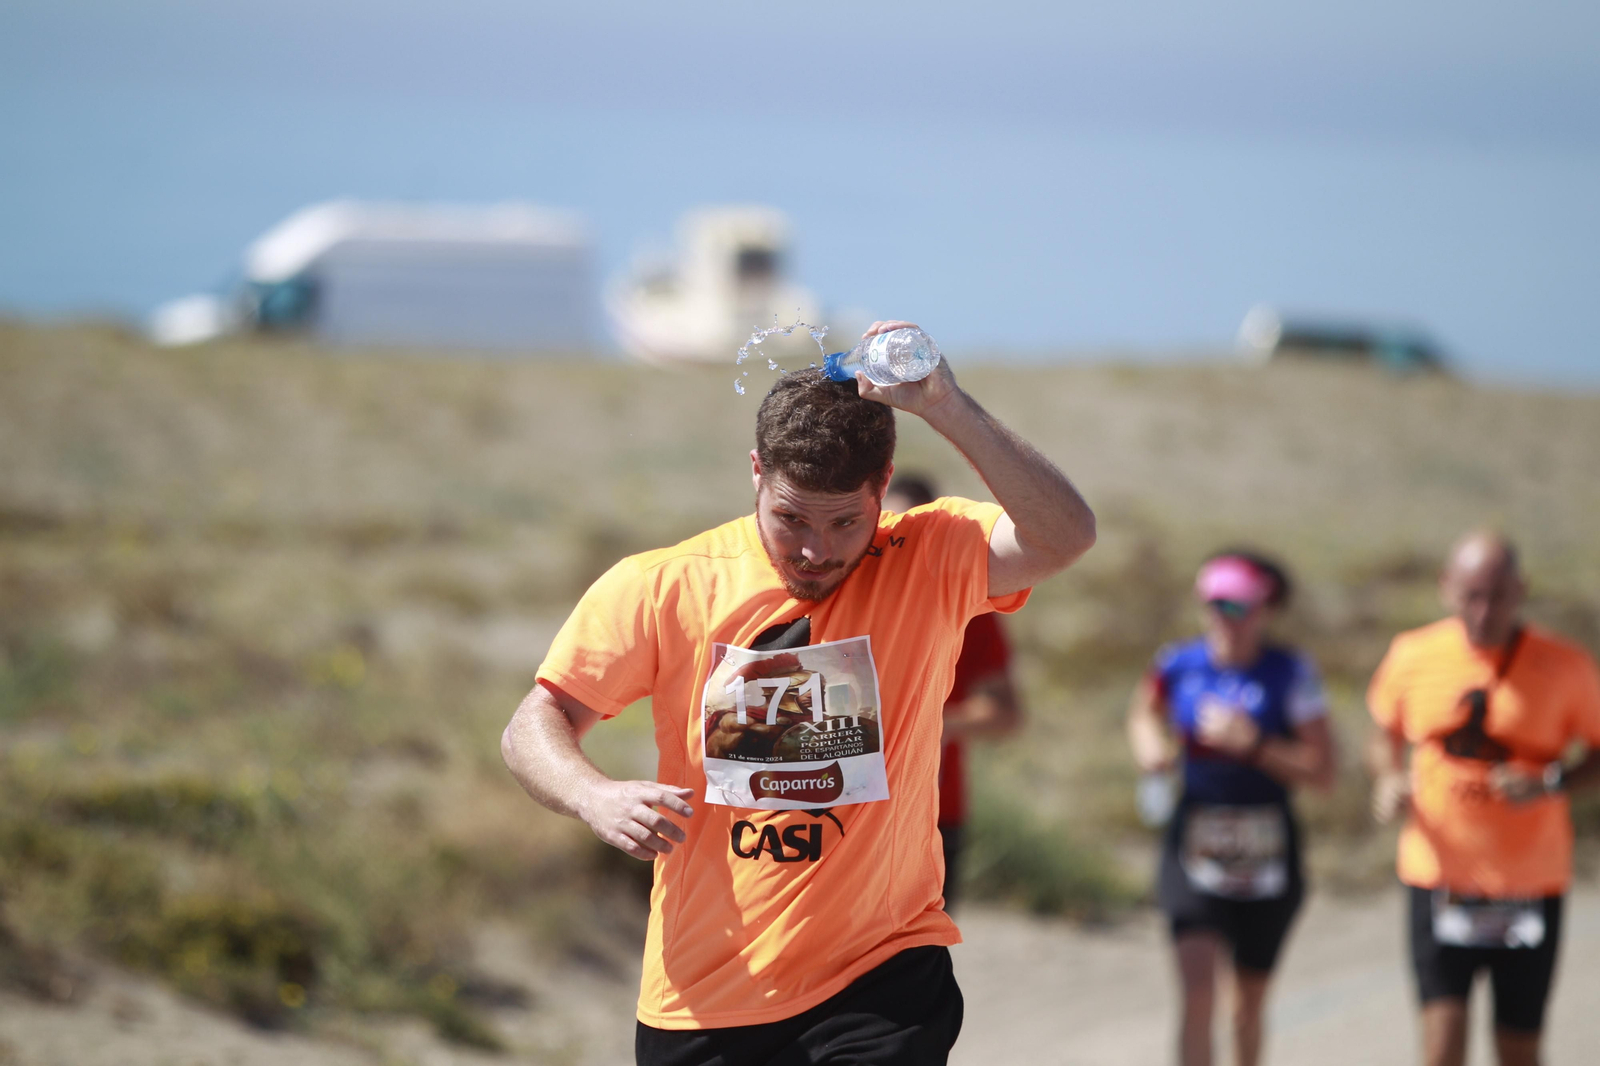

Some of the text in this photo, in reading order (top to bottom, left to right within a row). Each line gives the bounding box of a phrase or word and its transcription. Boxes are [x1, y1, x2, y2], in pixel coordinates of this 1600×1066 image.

[725, 672, 824, 726] 171
[800, 715, 862, 734] XIII
[800, 728, 863, 741] CARRERA
[801, 735, 862, 748] POPULAR
[815, 742, 864, 753] ESPARTANOS
[731, 820, 823, 862] CASI
